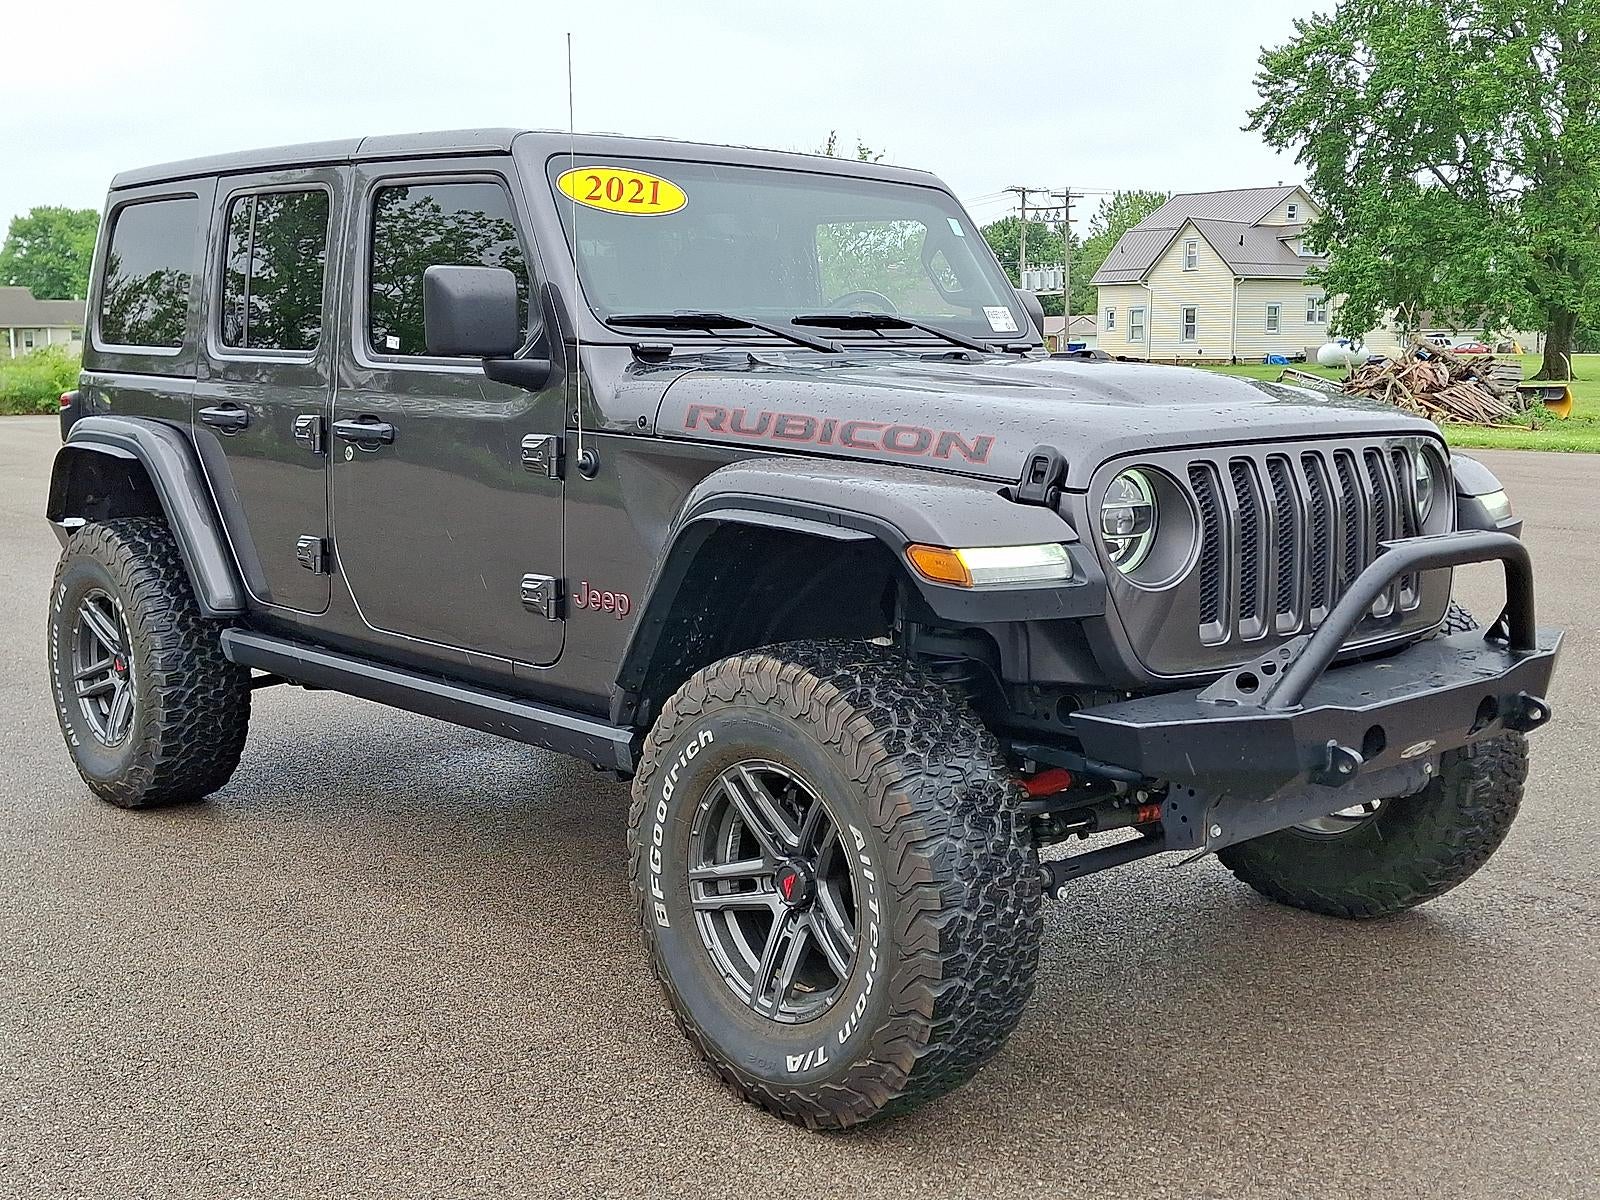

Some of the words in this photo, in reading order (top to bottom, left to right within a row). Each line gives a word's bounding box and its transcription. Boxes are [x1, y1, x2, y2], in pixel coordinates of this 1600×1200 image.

[585, 175, 661, 206] 2021
[684, 403, 996, 464] RUBICON
[573, 581, 631, 621] Jeep
[649, 728, 715, 928] BFGoodrich
[838, 824, 880, 1045] All-Terrain
[786, 1046, 829, 1072] T/A
